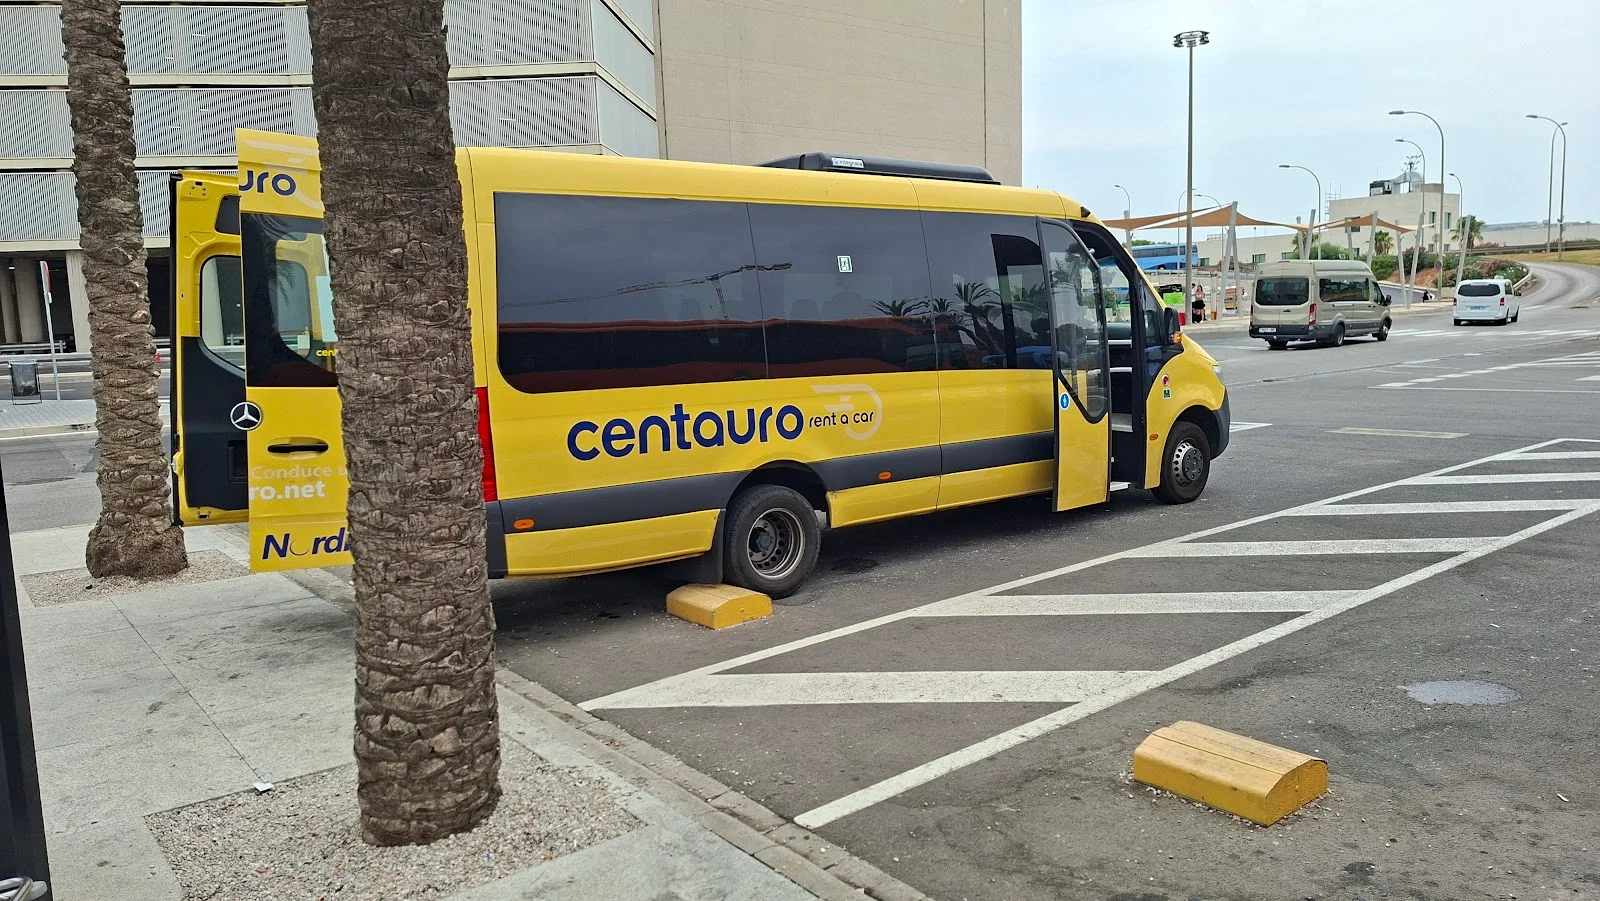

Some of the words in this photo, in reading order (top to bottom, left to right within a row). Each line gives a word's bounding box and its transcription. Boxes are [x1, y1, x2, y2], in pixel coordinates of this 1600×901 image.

[809, 412, 837, 428] rent
[840, 413, 849, 425] a
[853, 411, 874, 424] car
[567, 403, 804, 461] centauro
[251, 464, 332, 480] Conduce
[248, 480, 326, 501] ro.net
